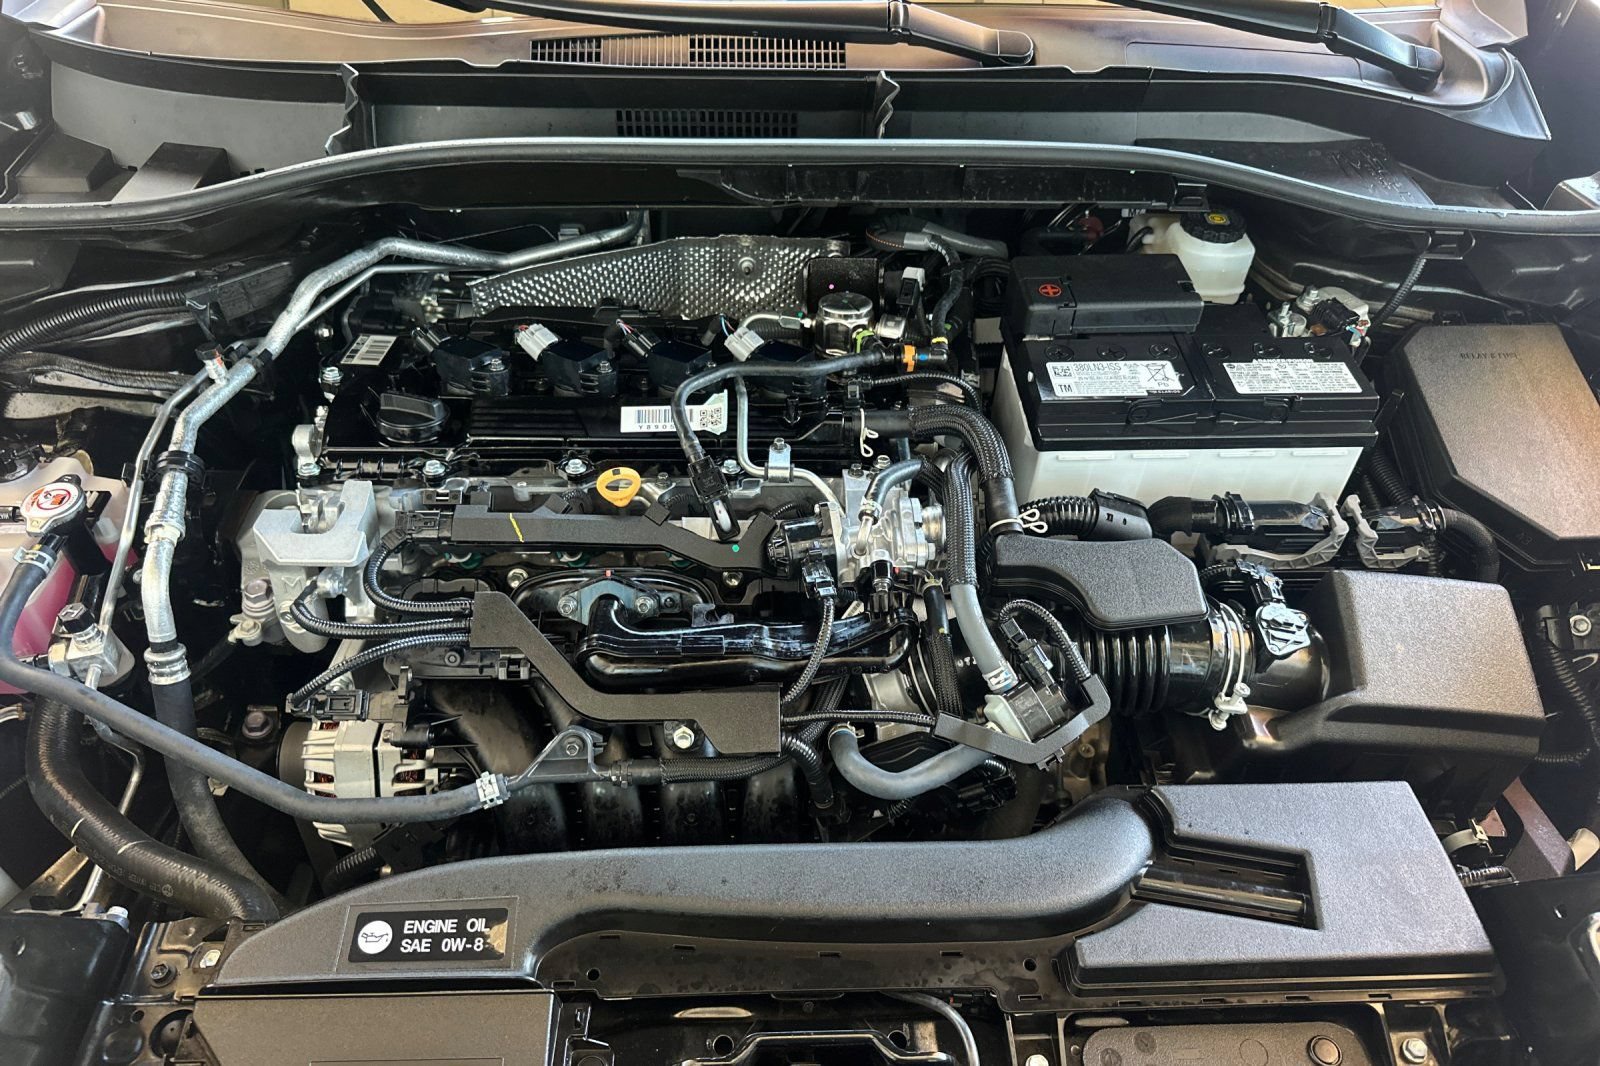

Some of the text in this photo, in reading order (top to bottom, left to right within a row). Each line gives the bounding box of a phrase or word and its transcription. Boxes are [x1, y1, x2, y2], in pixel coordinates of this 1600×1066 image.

[1058, 384, 1073, 393] TM
[403, 917, 491, 934] ENGINE OIL
[400, 937, 485, 953] SAE 0W-8
